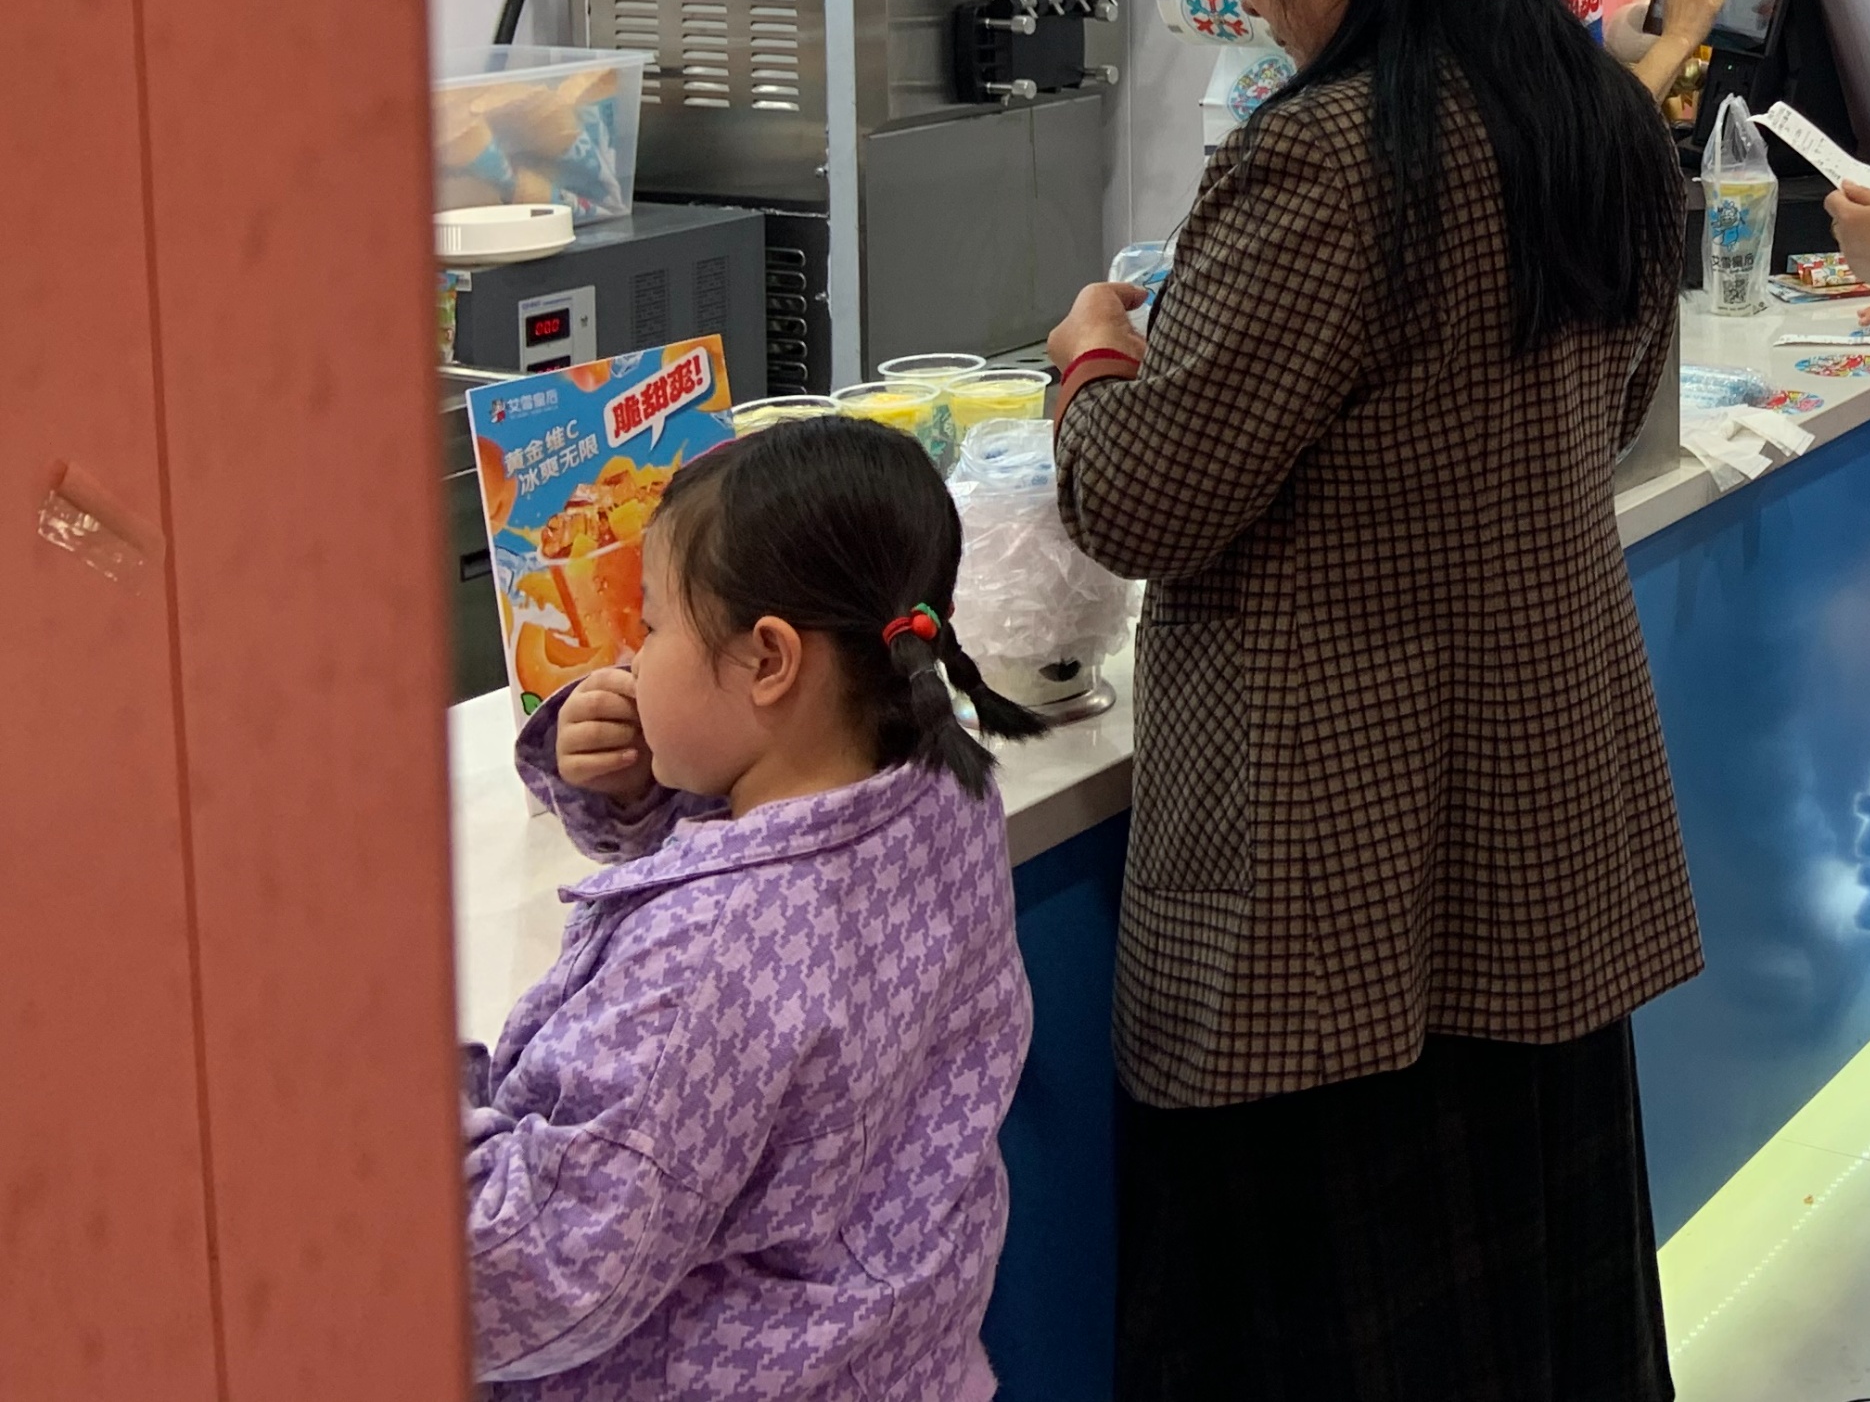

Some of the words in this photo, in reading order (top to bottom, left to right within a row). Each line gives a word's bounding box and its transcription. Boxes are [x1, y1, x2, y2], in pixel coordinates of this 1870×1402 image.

[612, 354, 703, 438] 脆甜爽!
[504, 418, 580, 476] 黄金维C
[518, 434, 599, 496] 冰爽无限
